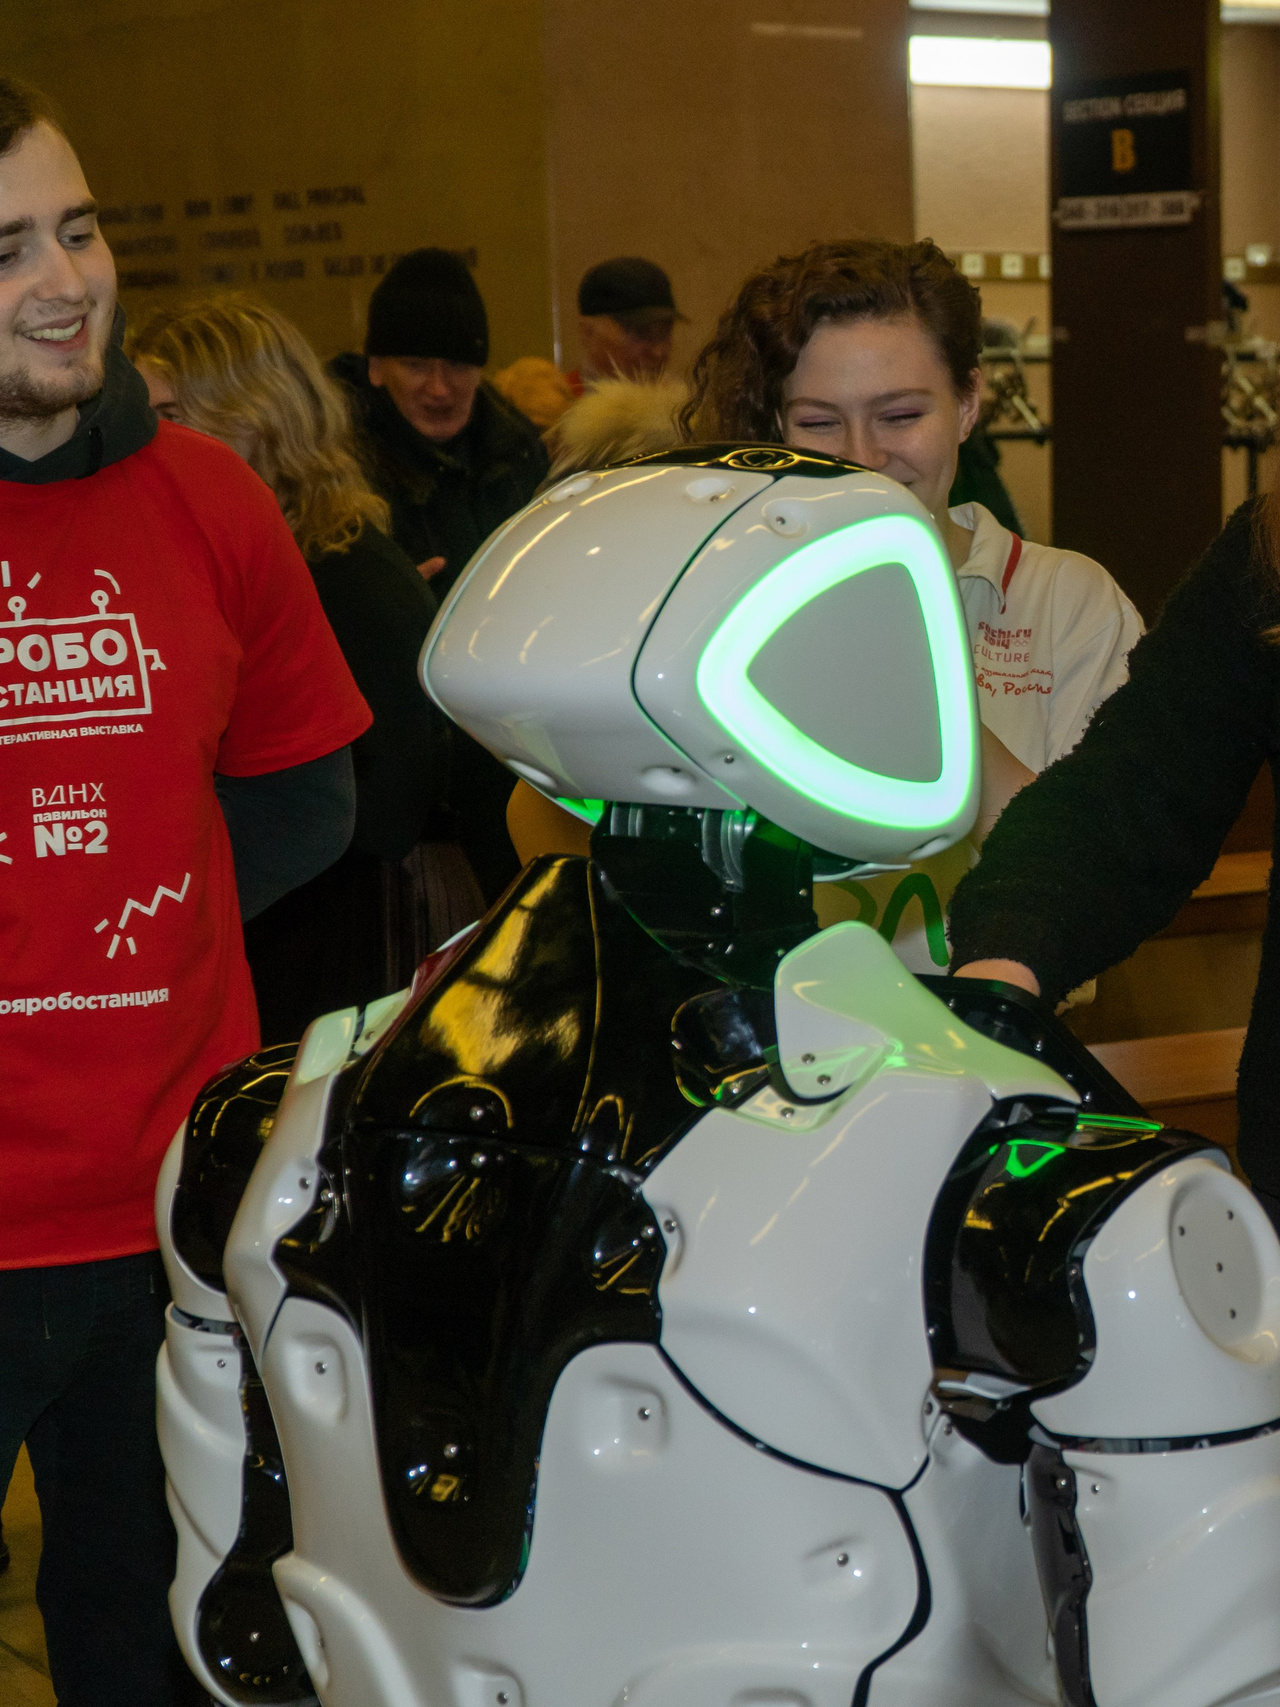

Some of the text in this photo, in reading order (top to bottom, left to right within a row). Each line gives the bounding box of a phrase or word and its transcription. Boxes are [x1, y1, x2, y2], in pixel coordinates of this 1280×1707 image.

[1111, 128, 1136, 174] B
[977, 621, 1032, 638] sochi.ru
[984, 632, 1011, 649] 2014
[973, 644, 1031, 663] CULTURE
[80, 723, 144, 737] ВЫСТАВКА
[32, 783, 107, 808] ВДНХ
[33, 808, 108, 823] павильон
[33, 820, 109, 858] №2
[0, 988, 170, 1016] ояробостанция
